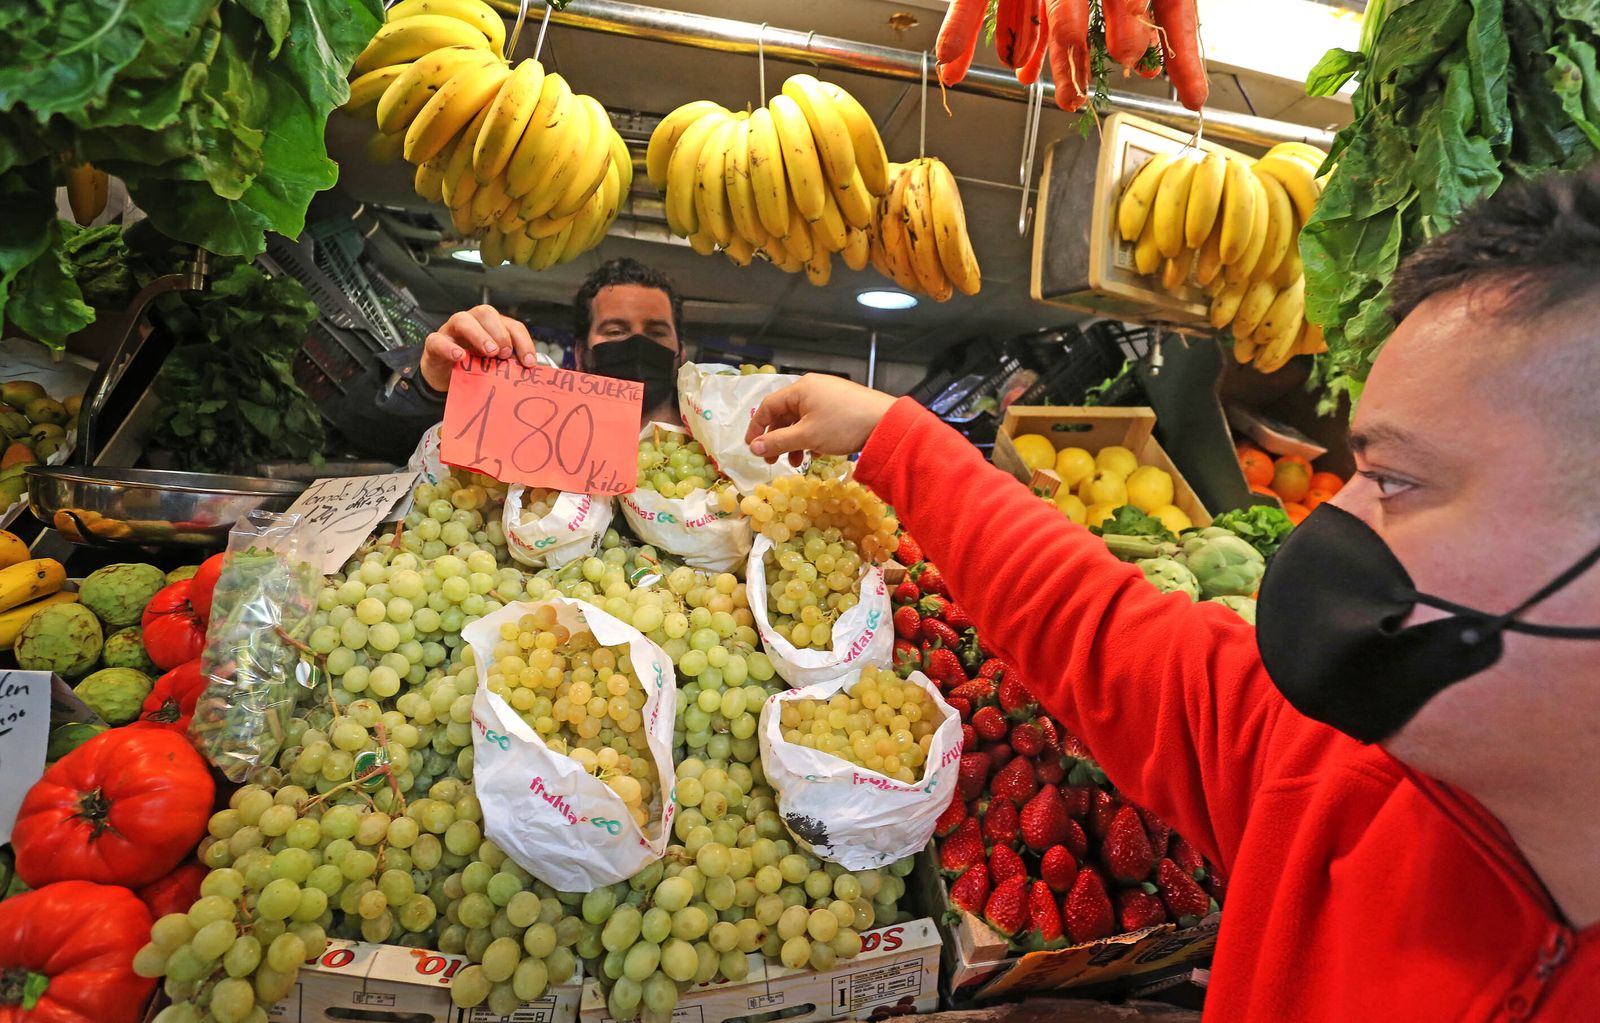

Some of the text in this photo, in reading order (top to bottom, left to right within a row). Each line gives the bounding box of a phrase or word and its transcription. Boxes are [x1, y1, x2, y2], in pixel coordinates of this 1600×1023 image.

[513, 367, 545, 388] DE
[547, 368, 575, 392] LA
[578, 373, 643, 402] SUERTE
[455, 384, 594, 480] 1,80
